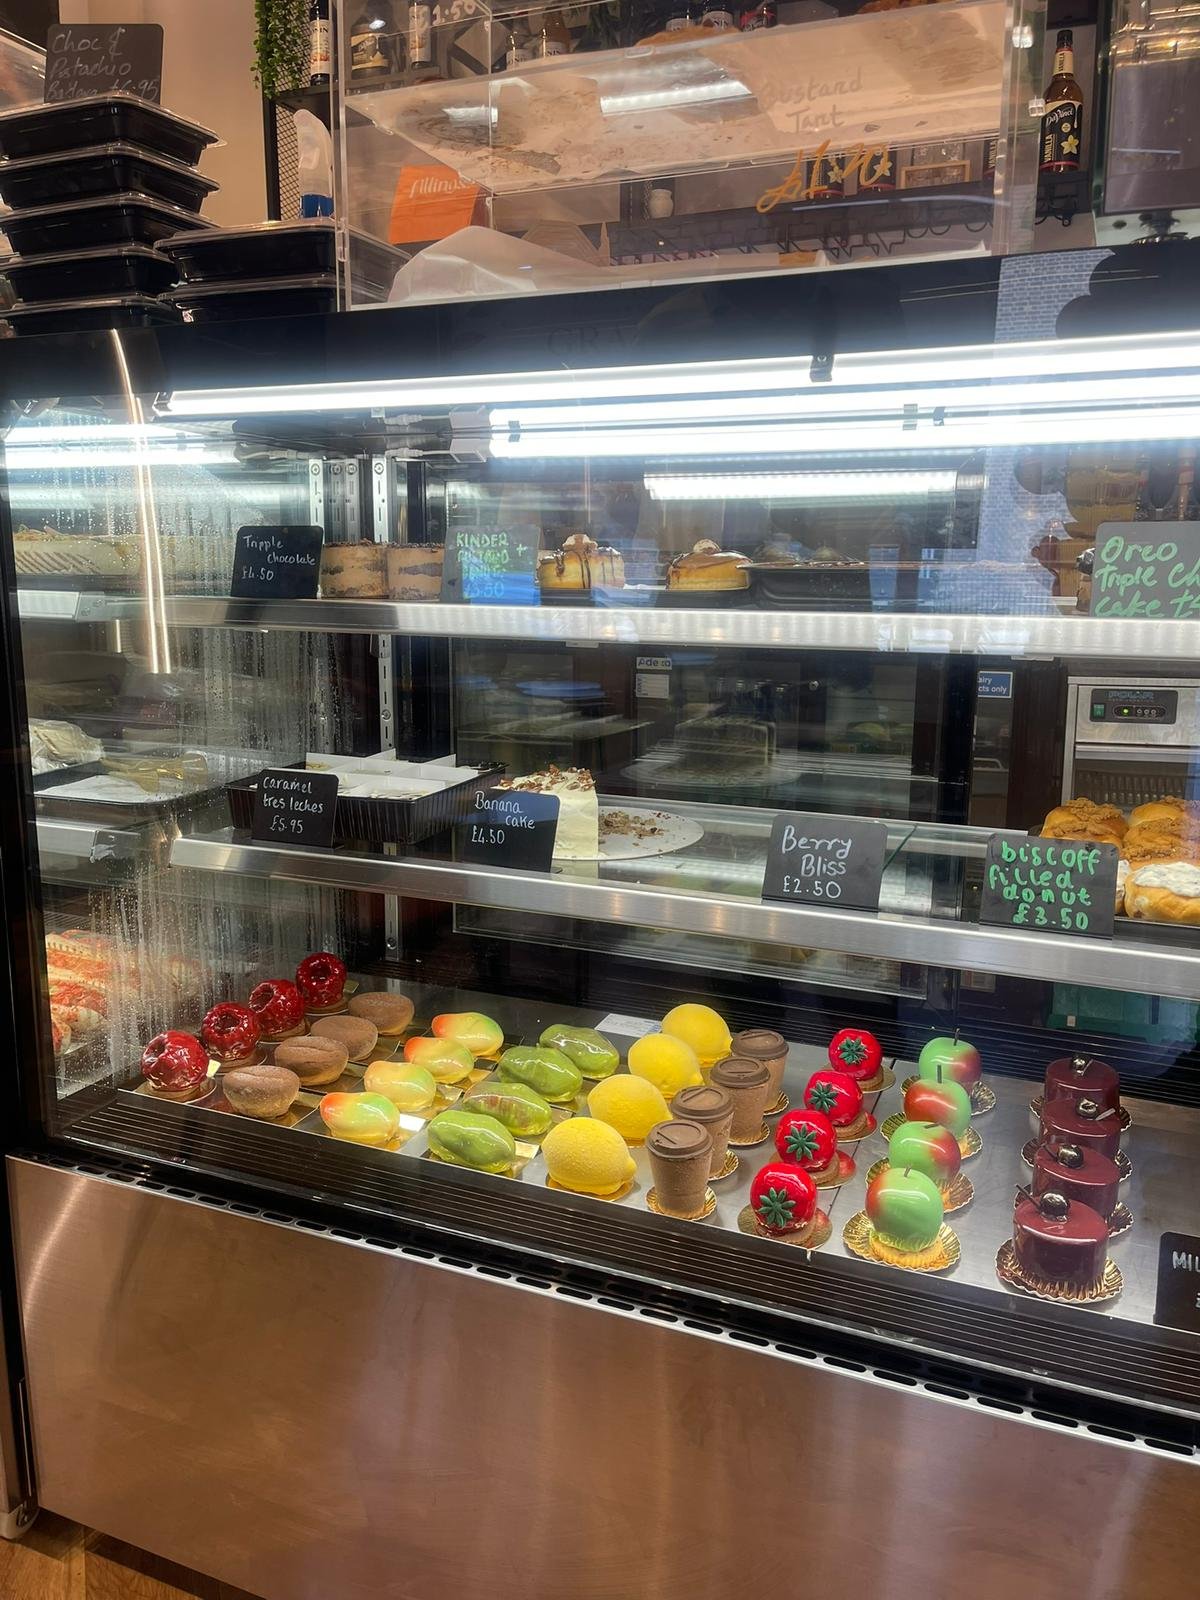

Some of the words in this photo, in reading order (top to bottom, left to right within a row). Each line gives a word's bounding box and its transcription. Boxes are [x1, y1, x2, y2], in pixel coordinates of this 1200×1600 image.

[52, 30, 101, 54] Choc
[1045, 109, 1074, 127] DaVinci
[1044, 133, 1054, 163] VANILLA
[243, 534, 284, 552] Tripple
[456, 532, 509, 548] KINDER
[1101, 535, 1178, 563] Oreo
[241, 566, 274, 581] £4.50
[1095, 563, 1157, 597] Triple
[991, 685, 1008, 694] only
[263, 793, 286, 809] tres
[289, 797, 324, 813] leches
[474, 790, 525, 814] Banana
[270, 814, 304, 834] £5.95
[471, 825, 505, 844] £4.50
[781, 825, 852, 859] Berry
[801, 853, 847, 877] Bliss
[783, 875, 841, 899] £2.50
[1002, 883, 1092, 906] donut
[1013, 902, 1089, 930] £3.50
